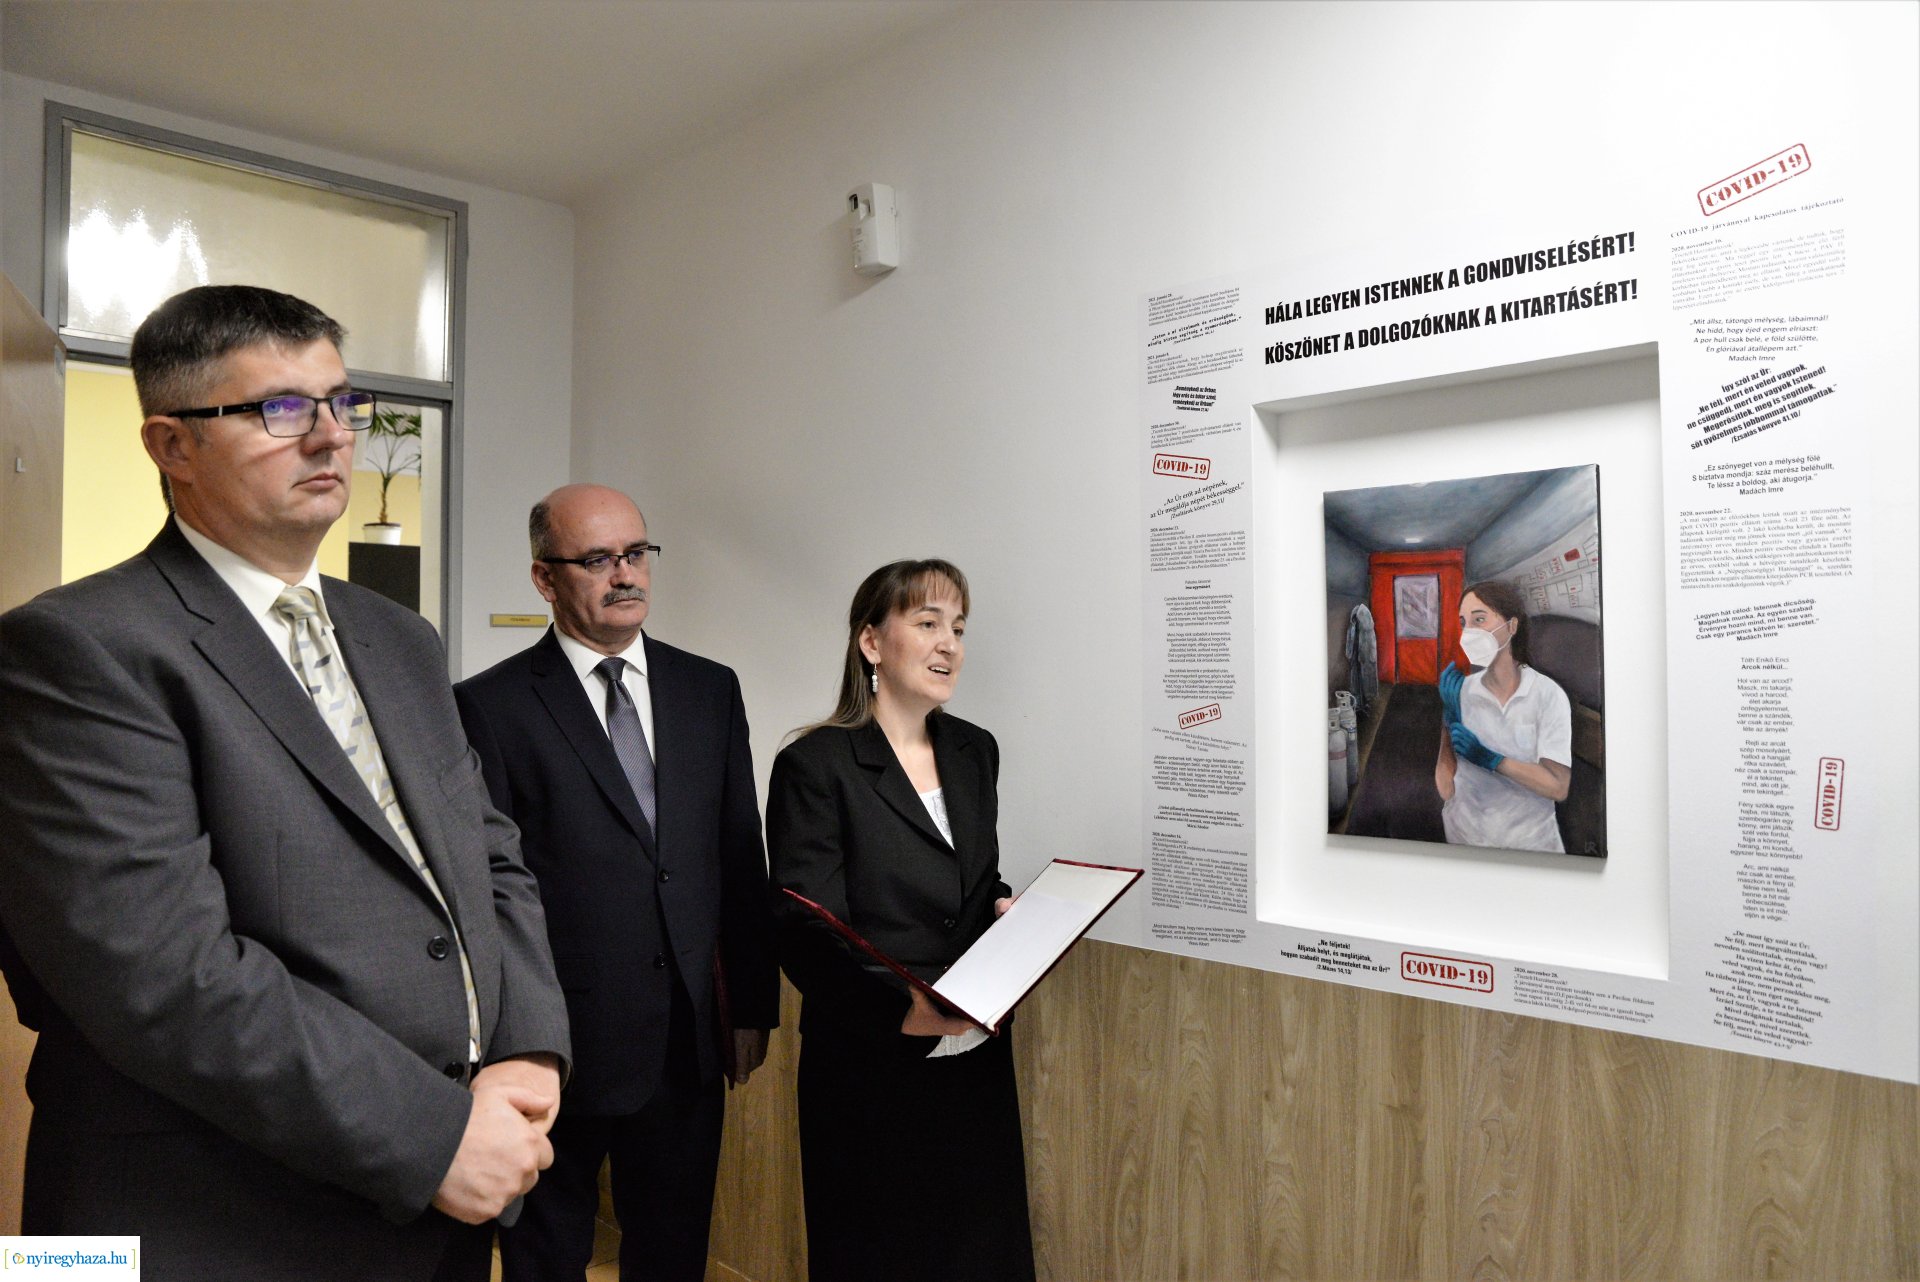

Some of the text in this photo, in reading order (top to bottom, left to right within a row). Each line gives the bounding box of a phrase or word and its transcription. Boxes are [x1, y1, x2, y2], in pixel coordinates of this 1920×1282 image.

[1705, 153, 1802, 207] COVID-19
[1265, 301, 1303, 326] HÁLA
[1305, 288, 1361, 317] LEGYEN
[1364, 271, 1445, 306] ISTENNEK
[1447, 268, 1460, 289] A
[1463, 231, 1635, 286] GONDVISELÉSÉRT!
[1265, 278, 1637, 365] KÖSZÖNET A DOLGOZÓKNAK A KITARTÁSÉRT!
[1156, 459, 1207, 475] COVID-19
[1181, 707, 1219, 725] COVID-19
[1821, 762, 1838, 826] COVID-19
[1406, 959, 1489, 985] COVID-19
